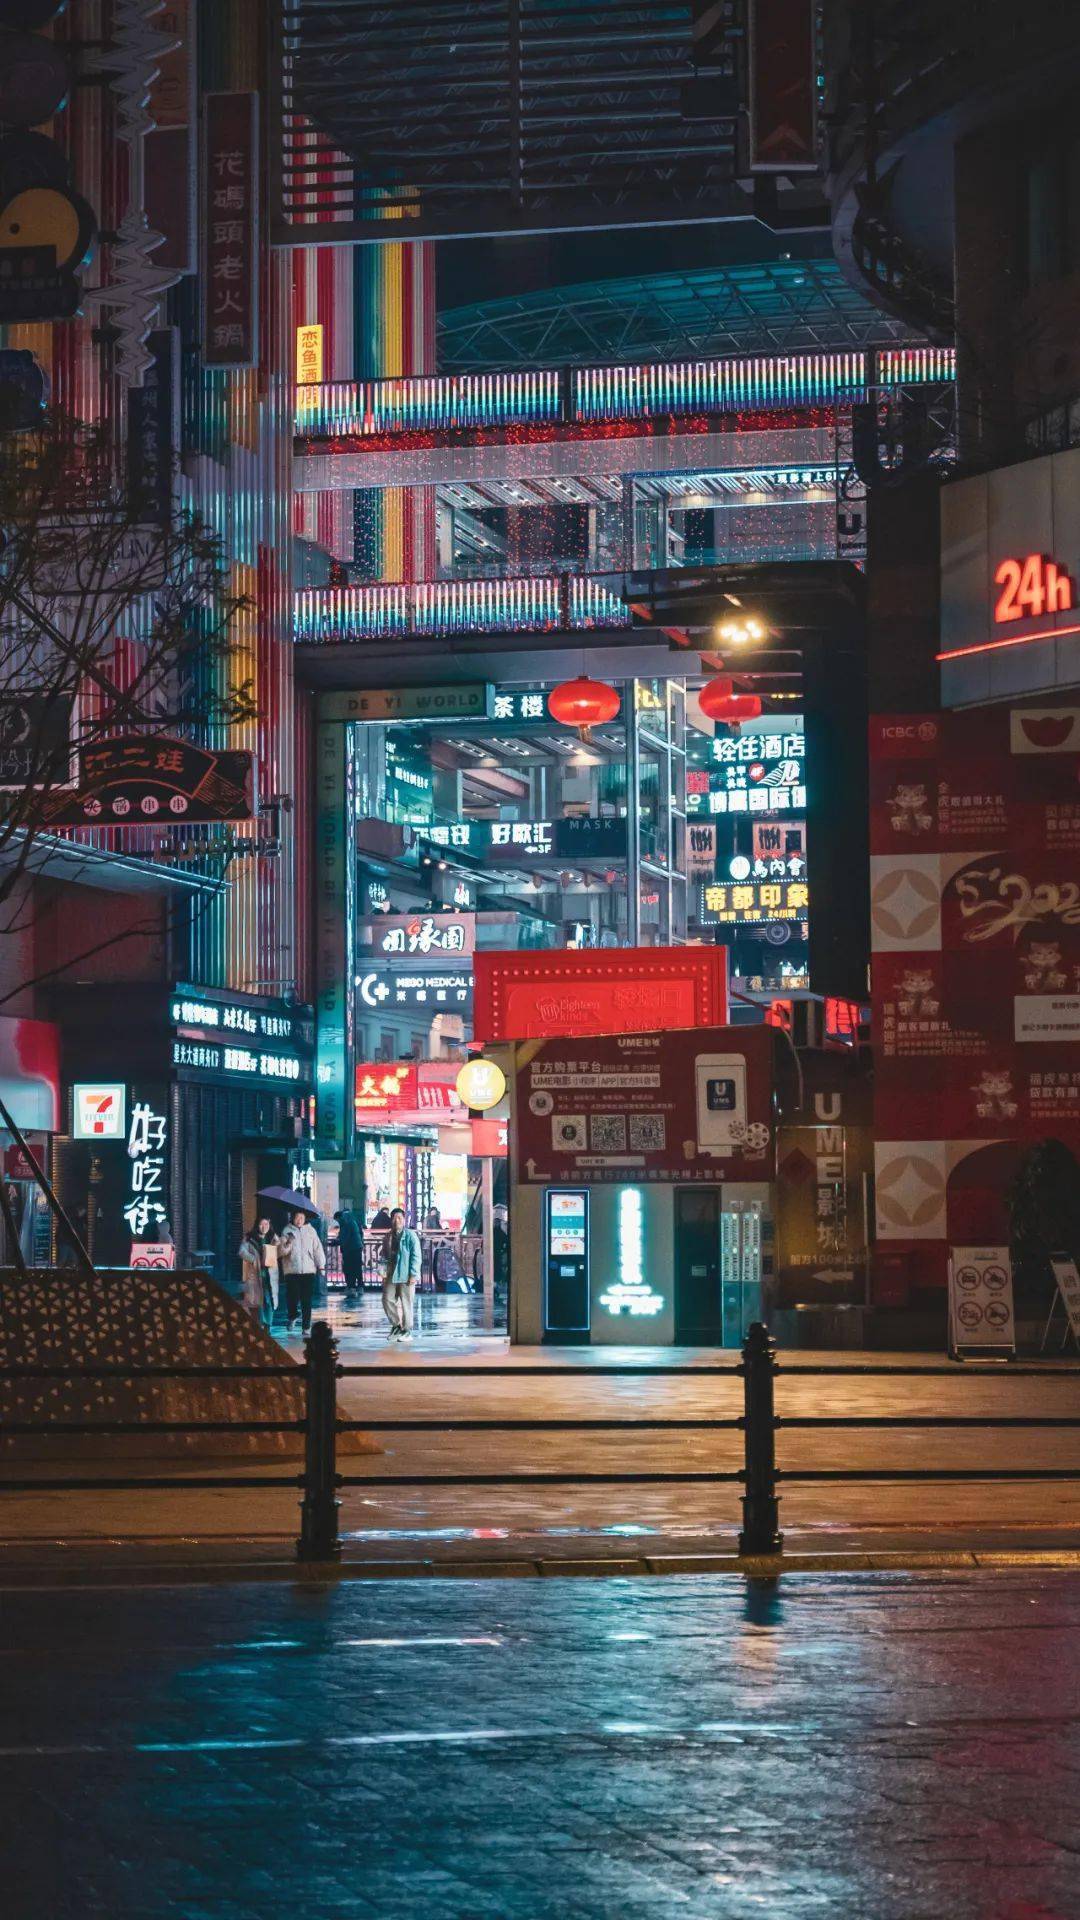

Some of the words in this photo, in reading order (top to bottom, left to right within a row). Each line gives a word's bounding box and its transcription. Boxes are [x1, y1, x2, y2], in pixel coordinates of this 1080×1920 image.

[212, 150, 244, 349] 花碼頭老火鍋
[995, 554, 1073, 623] 24h
[347, 699, 369, 711] DE
[385, 697, 401, 709] YI
[416, 693, 479, 709] WORLD
[494, 695, 544, 719] 茶楼
[882, 727, 915, 738] ICBC
[712, 733, 805, 762] 轻住酒店
[569, 820, 612, 831] MASK
[537, 844, 552, 853] 3F
[705, 883, 808, 911] 帝都印象
[425, 977, 467, 988] MEDICAL
[531, 1061, 601, 1073] 官方购票平台
[123, 1103, 167, 1235] 好吃街
[814, 1092, 847, 1249] UME影城
